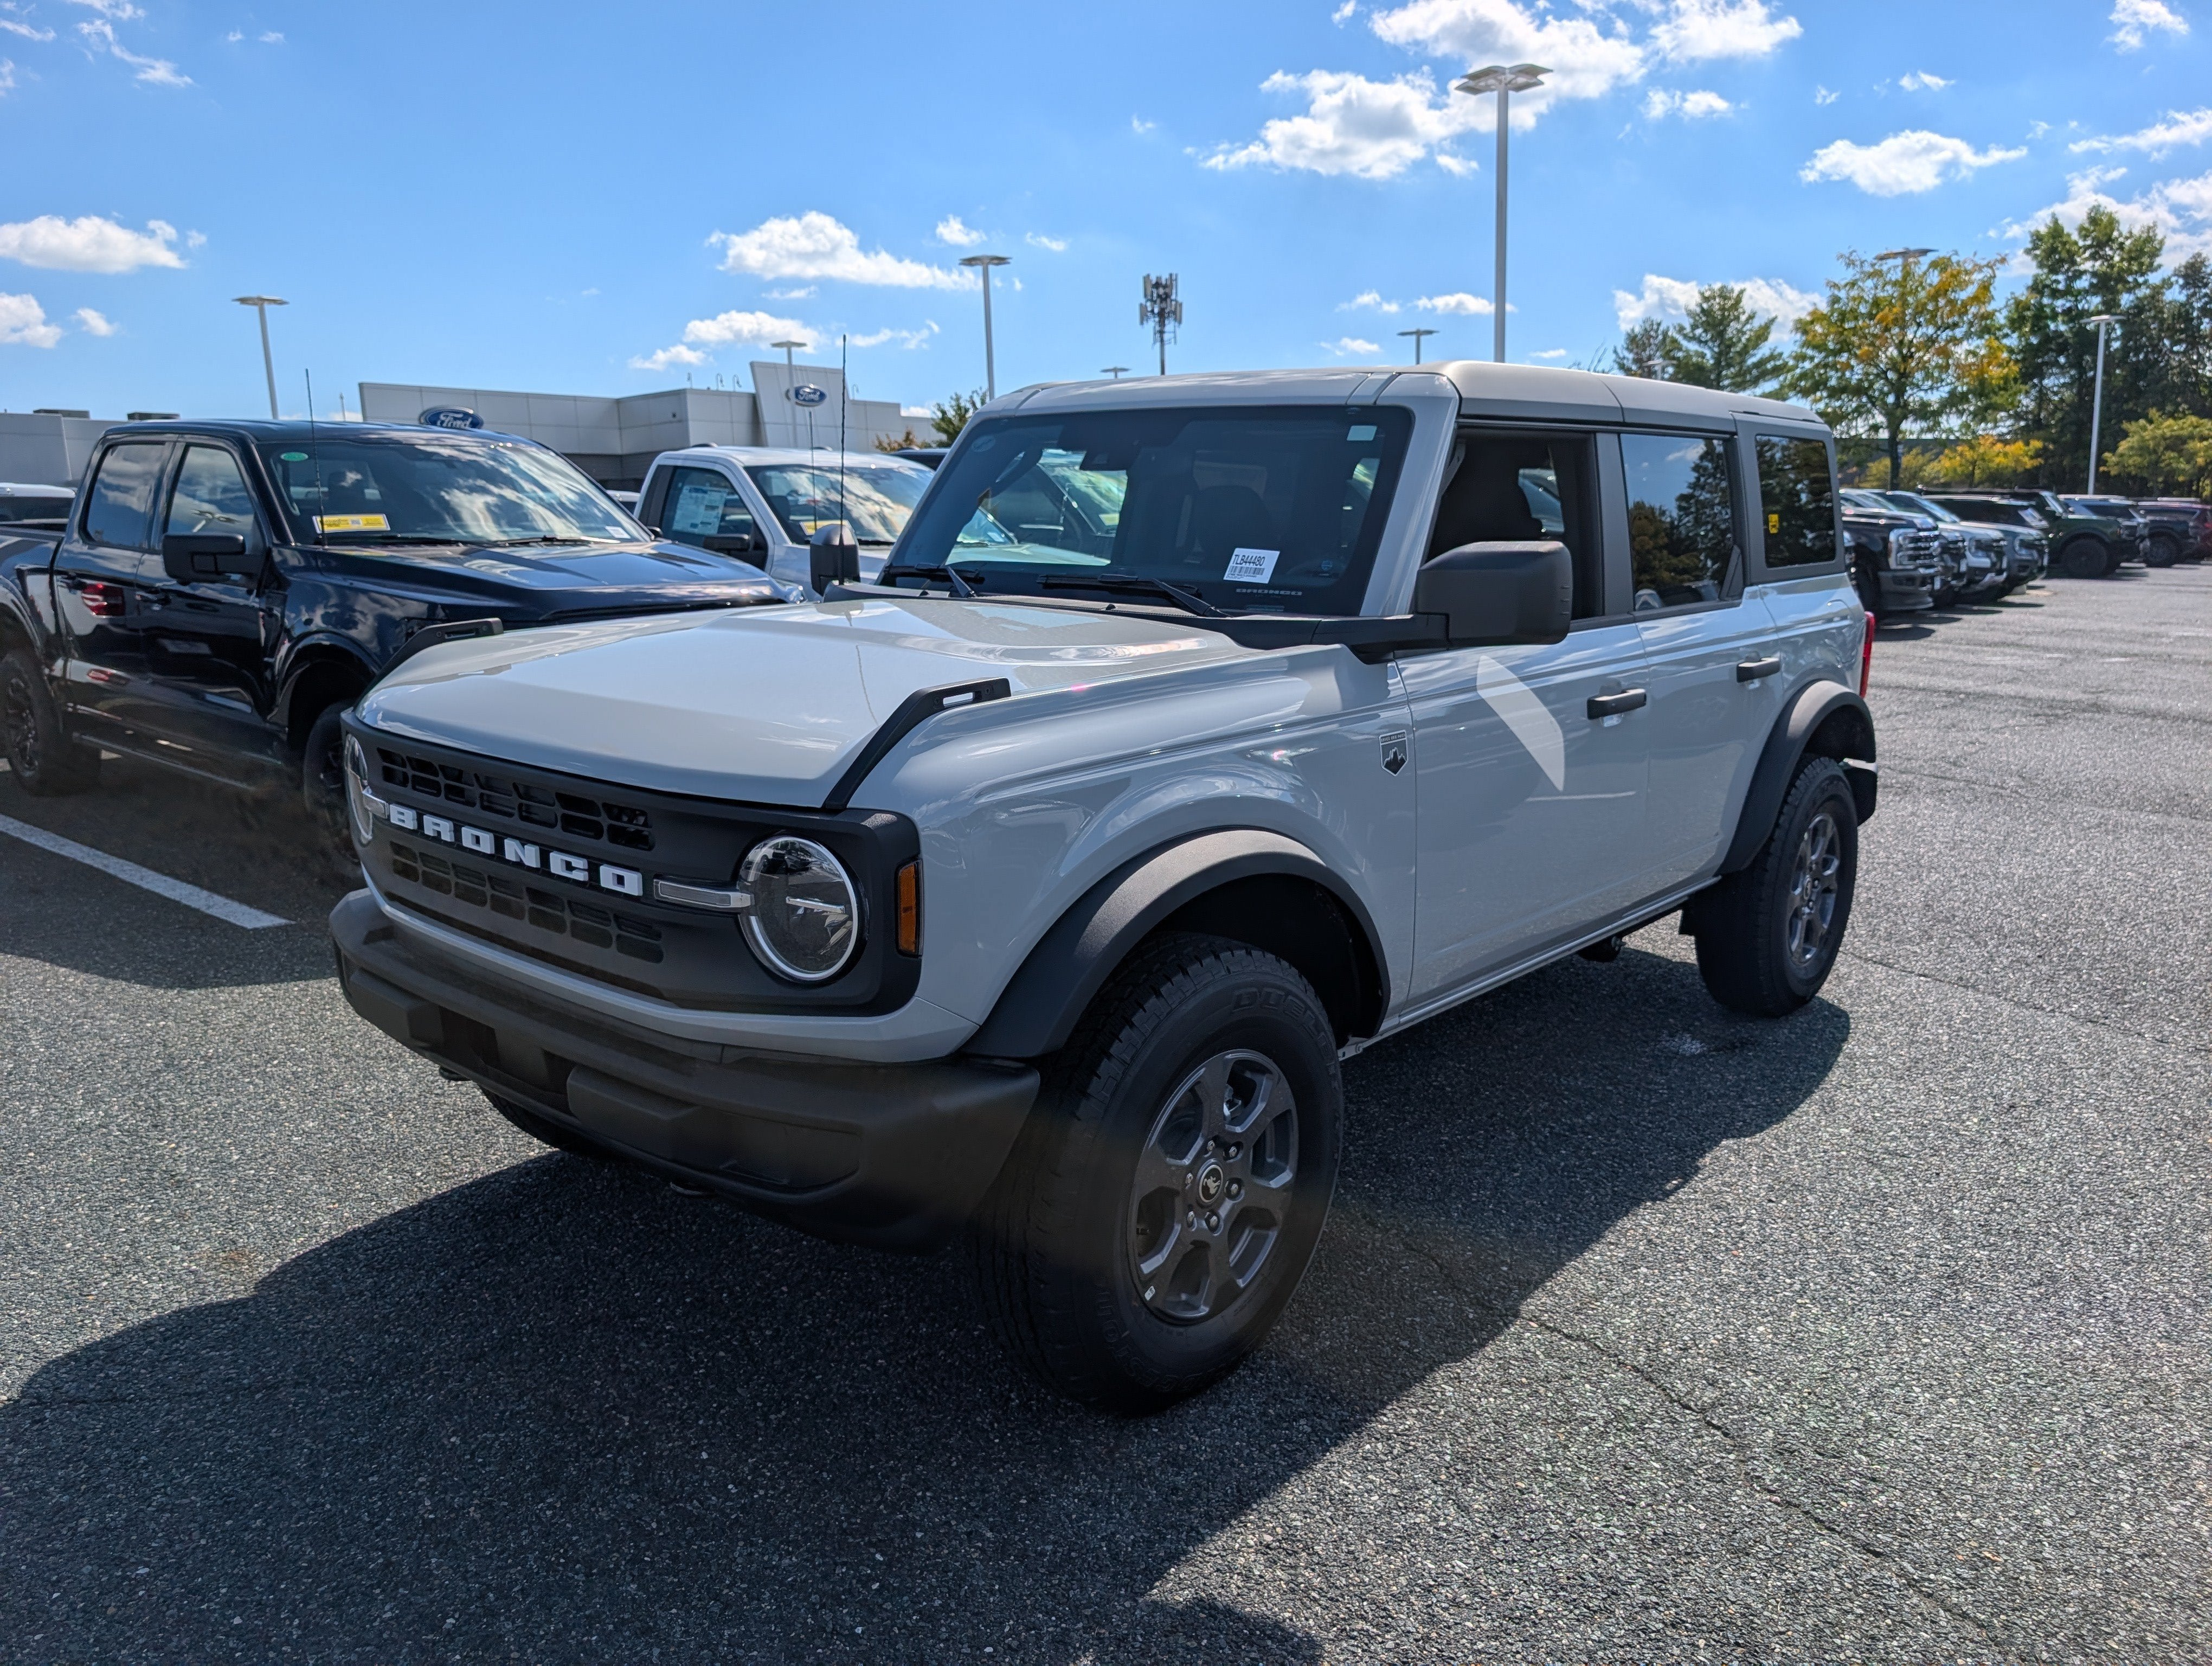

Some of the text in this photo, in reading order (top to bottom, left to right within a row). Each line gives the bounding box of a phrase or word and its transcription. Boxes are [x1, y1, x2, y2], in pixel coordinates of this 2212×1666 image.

[798, 387, 820, 400] Ford
[437, 412, 472, 429] Ford
[1232, 554, 1265, 566] TLB44480
[390, 804, 643, 896] BRONCO
